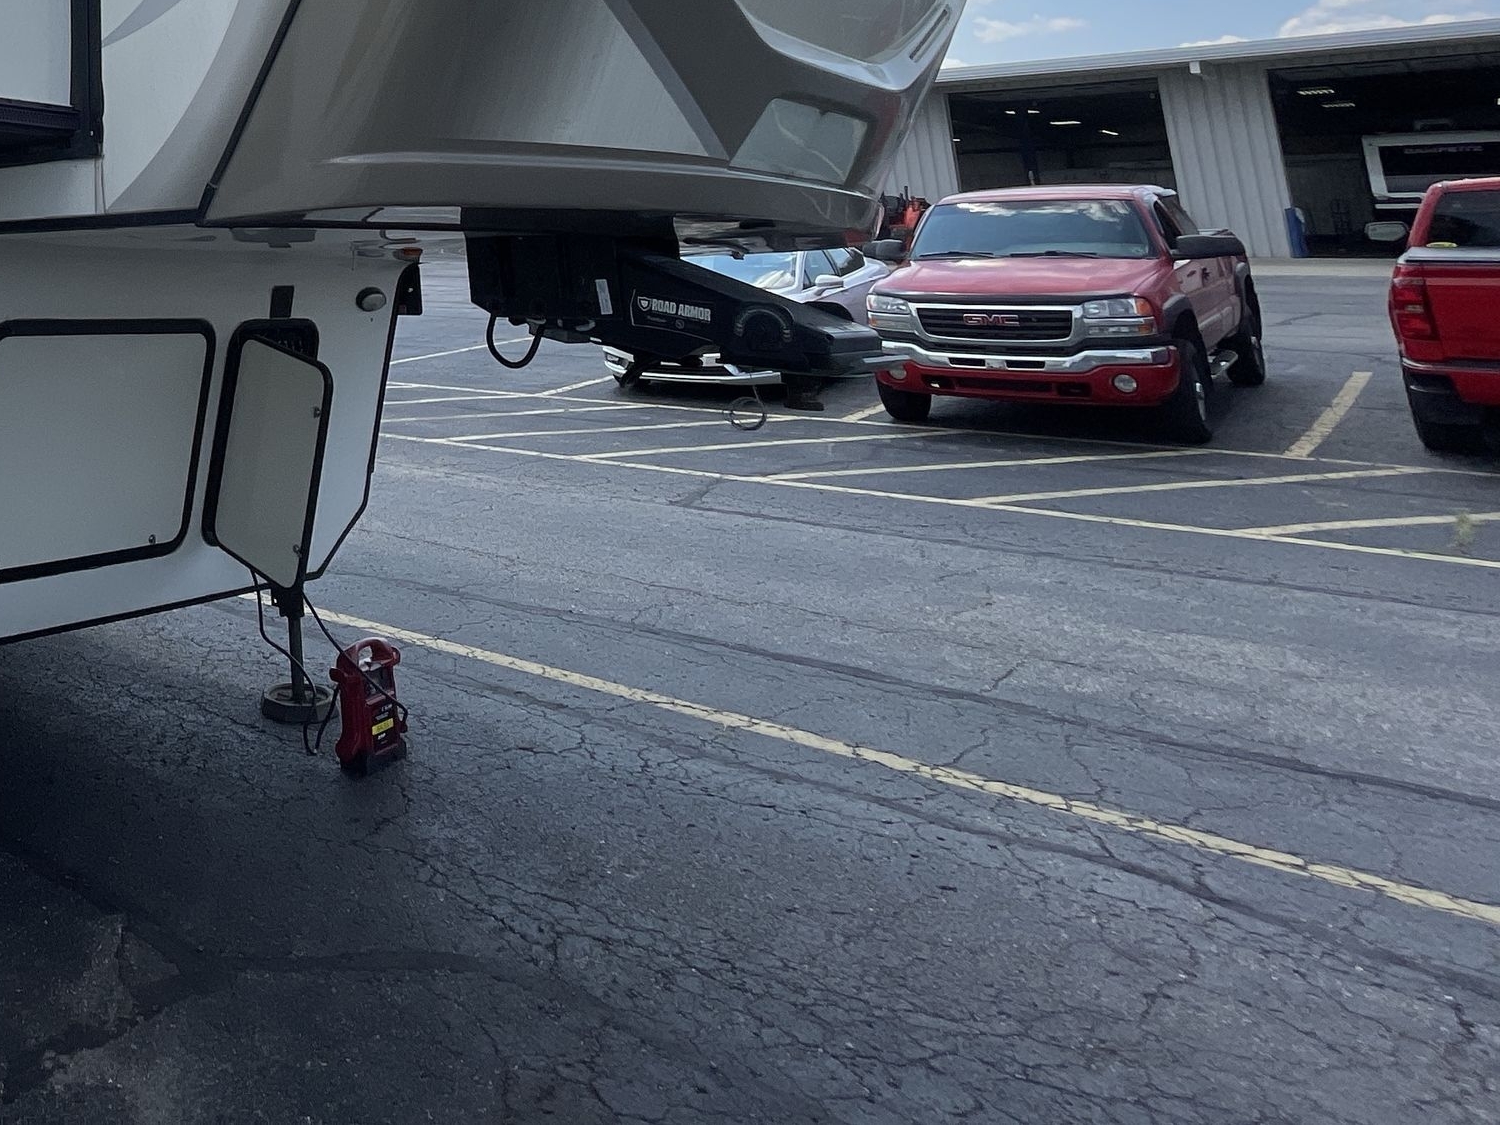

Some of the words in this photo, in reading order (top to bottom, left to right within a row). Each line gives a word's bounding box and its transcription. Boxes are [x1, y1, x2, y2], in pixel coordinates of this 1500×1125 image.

[651, 298, 677, 315] ROAD
[677, 303, 711, 322] ARMOR
[963, 313, 1020, 327] GMC
